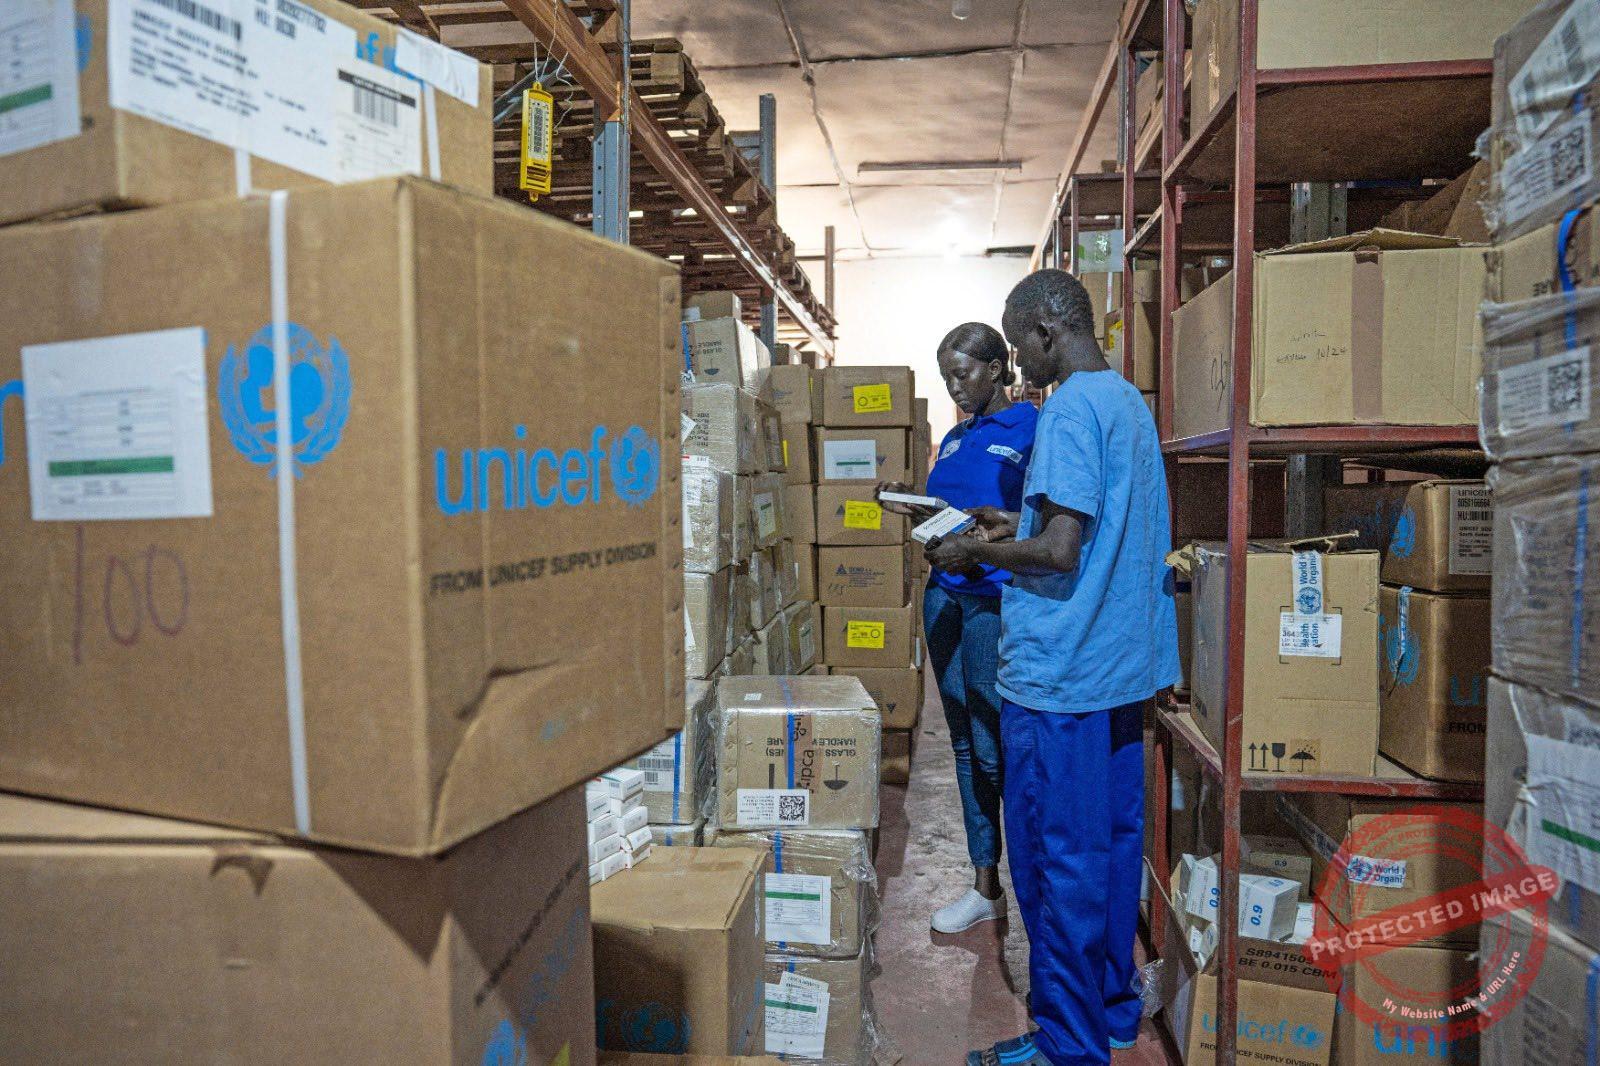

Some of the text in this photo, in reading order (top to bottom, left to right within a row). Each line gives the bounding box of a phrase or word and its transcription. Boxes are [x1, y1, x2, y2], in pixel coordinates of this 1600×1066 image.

[434, 423, 607, 516] unicef
[430, 542, 656, 595] FROM UNICEF SUPPLY DIVISION
[819, 737, 856, 747] HANDLE
[824, 749, 856, 758] GLASS
[1274, 859, 1288, 867] 0.9
[1374, 864, 1399, 875] World
[1209, 887, 1221, 908] 0.9
[1251, 905, 1263, 926] 0.9
[1261, 961, 1298, 974] 0.015
[1302, 967, 1337, 979] CBM
[1201, 1009, 1289, 1046] uicef
[1254, 1052, 1284, 1063] SUPPLY
